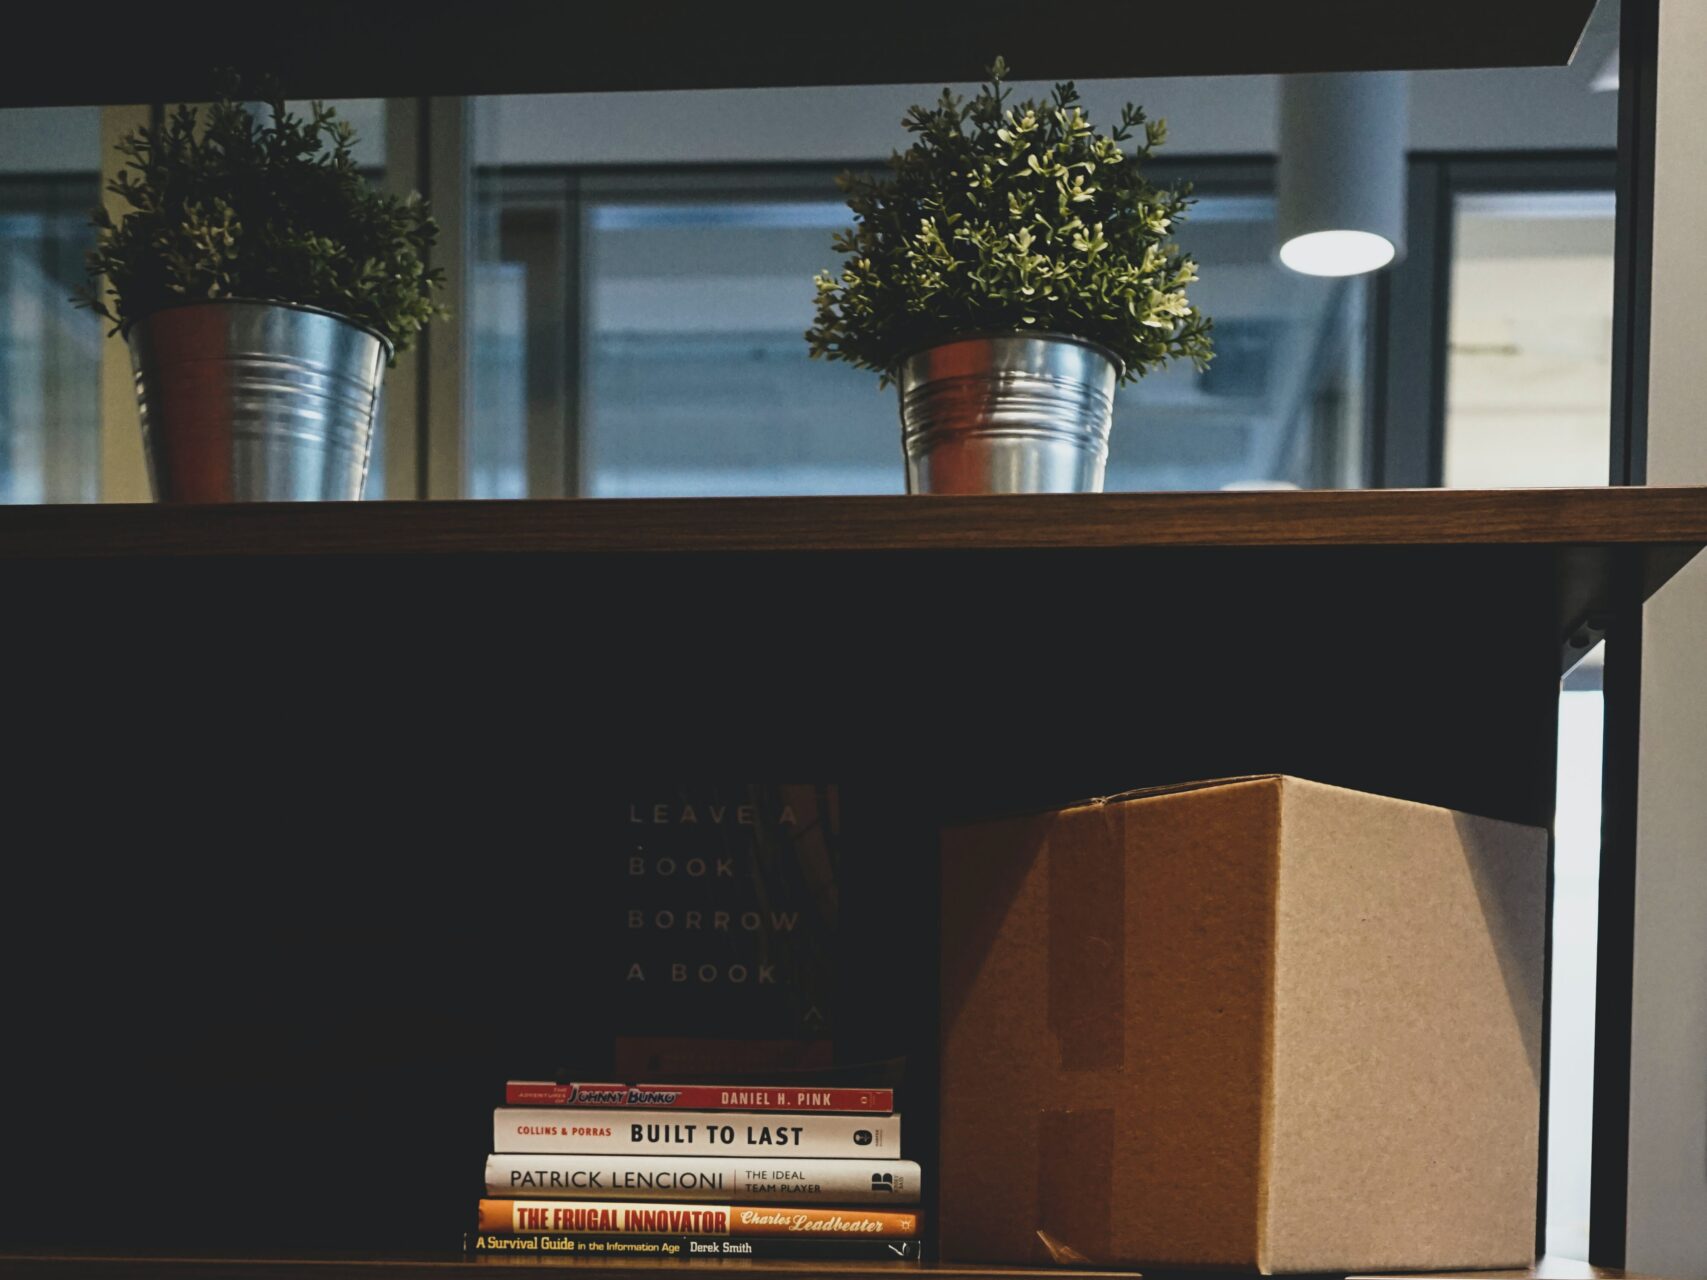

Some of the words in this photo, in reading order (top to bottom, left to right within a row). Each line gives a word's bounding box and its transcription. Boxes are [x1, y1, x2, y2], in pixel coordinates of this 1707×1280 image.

[629, 804, 756, 824] LEAVE
[778, 805, 798, 825] A
[628, 856, 734, 877] BOOK
[628, 910, 800, 932] BORROW
[626, 962, 646, 981] A
[721, 1092, 770, 1106] DANIEL
[777, 1092, 792, 1106] H.
[798, 1092, 831, 1106] PINK
[517, 1126, 558, 1136] COLLINS
[561, 1127, 568, 1136] &
[571, 1127, 612, 1137] PORRAS
[630, 1124, 697, 1144] BUILT
[706, 1125, 735, 1145] TO
[747, 1126, 804, 1146] LAST
[510, 1170, 602, 1189] PATRICK
[612, 1171, 723, 1190] LENCIONI
[745, 1170, 766, 1180] THE
[770, 1170, 805, 1180] IDEAL
[745, 1183, 776, 1194] TEAM
[780, 1184, 821, 1194] PLAYER
[517, 1208, 550, 1232] THE
[552, 1208, 620, 1233] FRUGAL
[624, 1209, 728, 1234] INNOVATOR
[740, 1211, 792, 1226] Charles
[789, 1214, 884, 1233] Leadbeater
[476, 1237, 486, 1248] A
[487, 1237, 538, 1250] Survival
[540, 1237, 574, 1250] Guide
[577, 1242, 587, 1251] in
[589, 1242, 604, 1251] the
[606, 1242, 659, 1252] Information
[662, 1243, 680, 1254] Age
[689, 1242, 720, 1253] Derek
[722, 1242, 752, 1254] Smith
